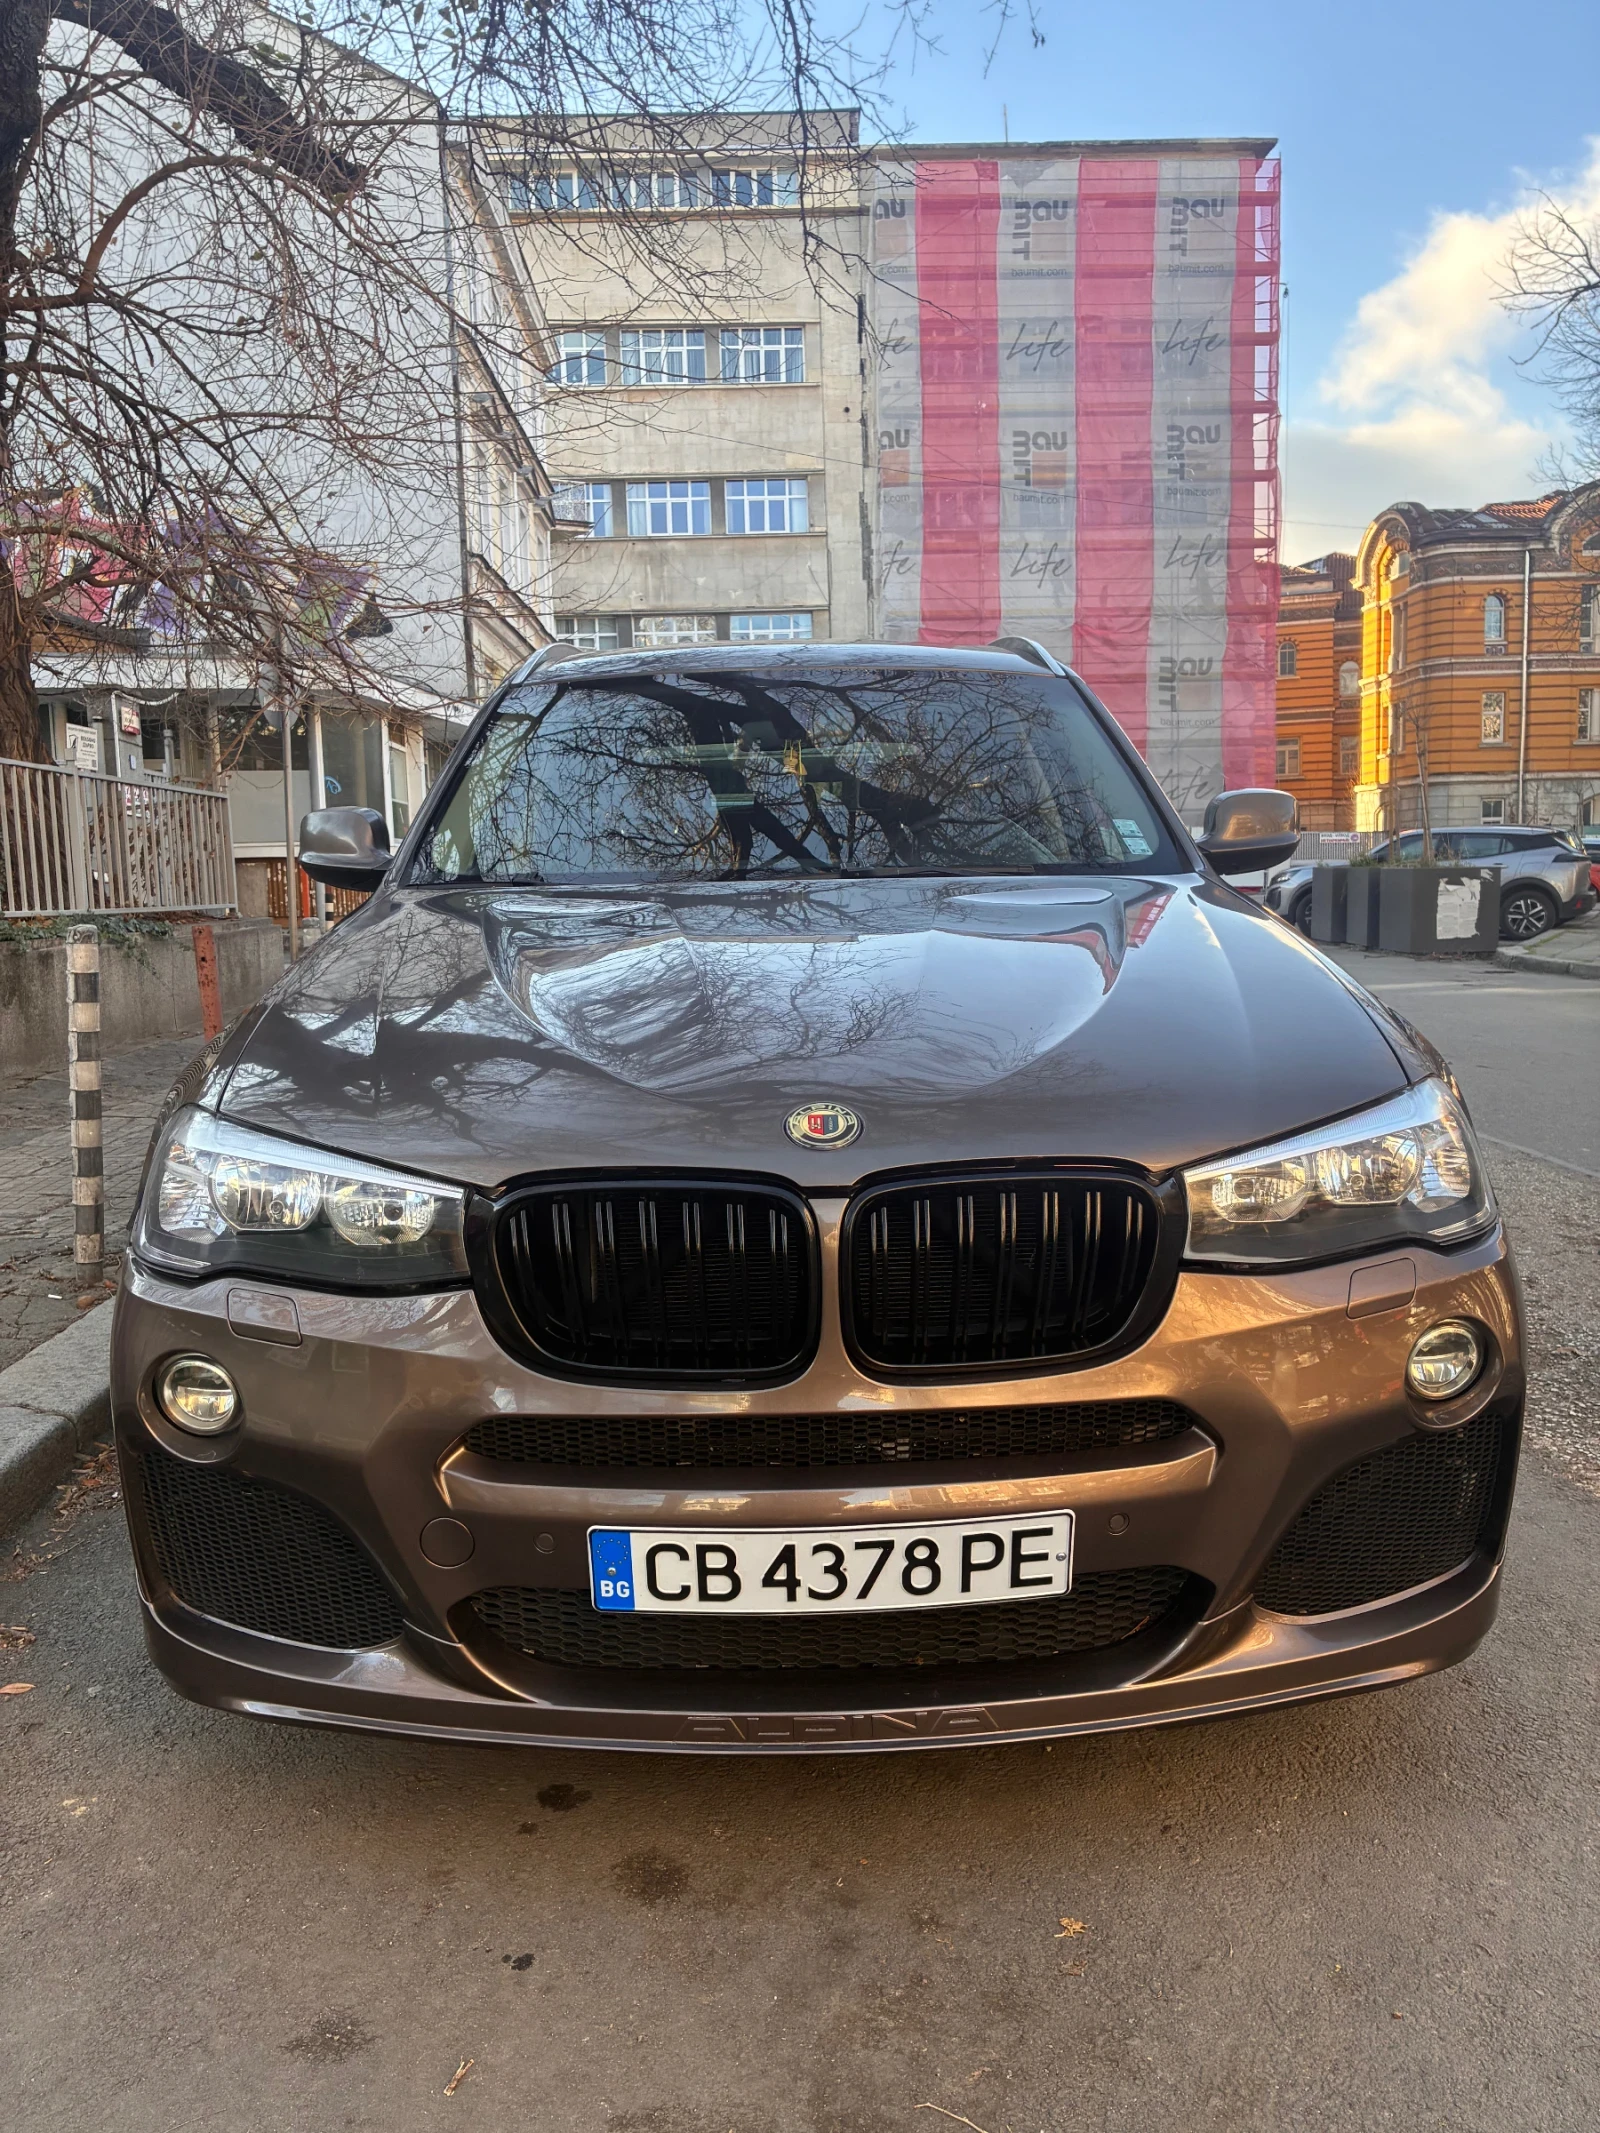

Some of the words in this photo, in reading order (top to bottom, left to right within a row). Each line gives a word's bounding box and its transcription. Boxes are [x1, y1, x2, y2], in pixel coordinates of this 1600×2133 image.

[1011, 268, 1067, 277] baumit.com
[1168, 264, 1224, 273] baumit.com
[792, 1104, 855, 1126] ALPINA
[645, 1543, 742, 1602] CB
[761, 1537, 942, 1603] 4378
[960, 1526, 1055, 1594] PE
[600, 1580, 630, 1598] BG
